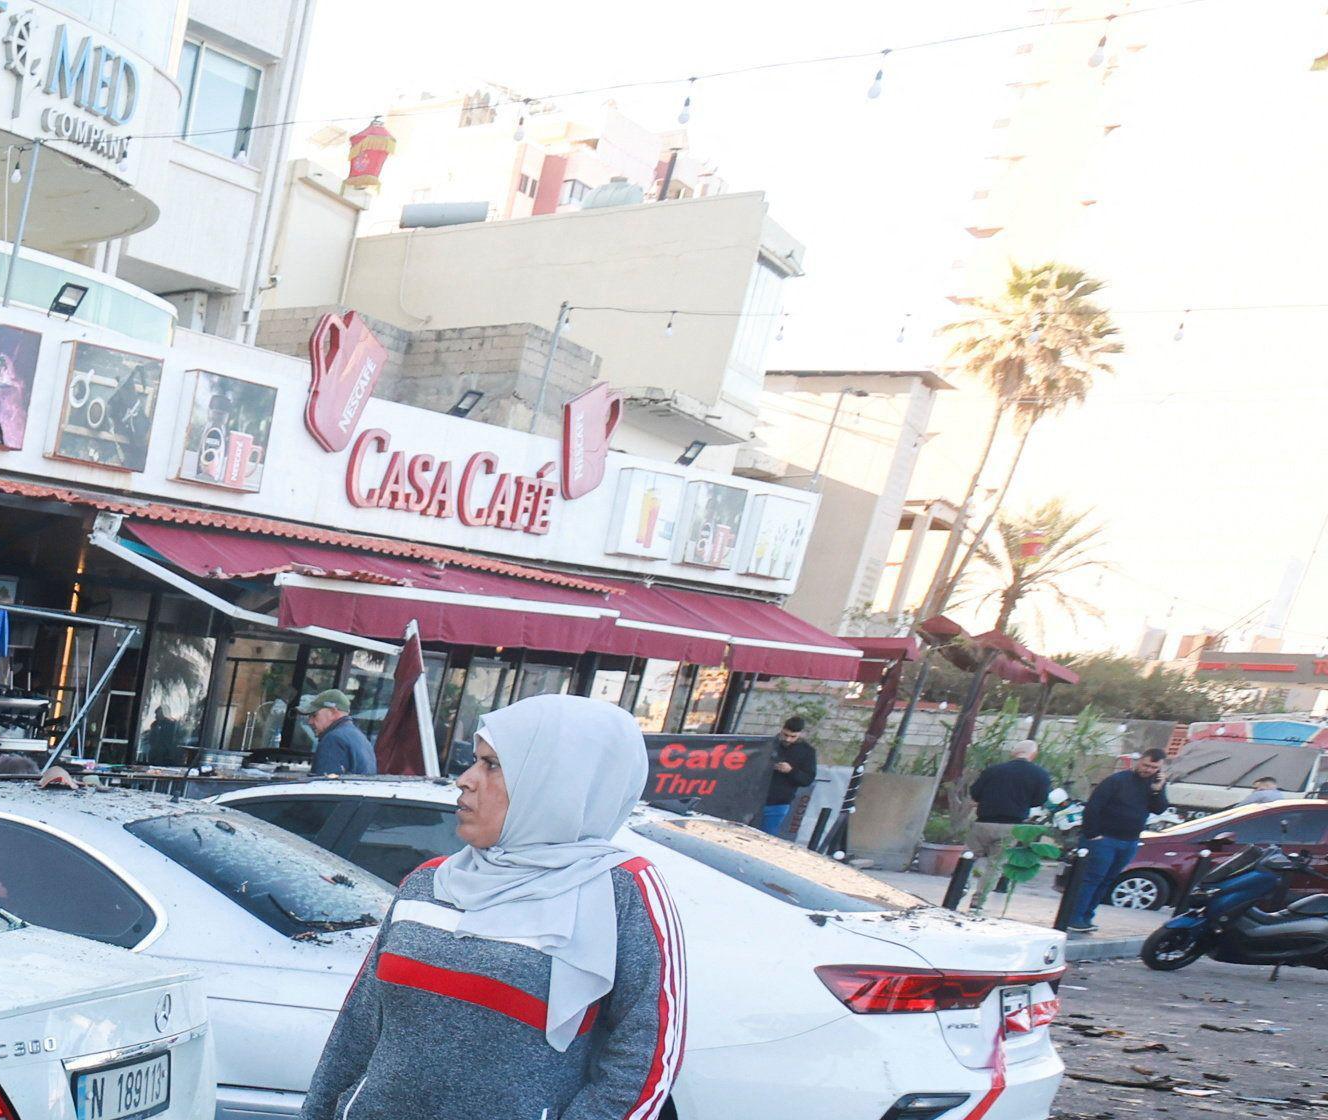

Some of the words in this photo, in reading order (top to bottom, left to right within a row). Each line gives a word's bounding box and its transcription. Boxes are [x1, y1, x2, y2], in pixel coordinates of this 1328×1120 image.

[43, 24, 140, 126] MED
[41, 107, 130, 164] COMPANY
[346, 428, 454, 518] CASA
[457, 451, 557, 535] CAFÉ
[655, 773, 718, 796] Thru
[659, 743, 748, 771] Café
[14, 1037, 57, 1056] 300
[91, 1077, 105, 1119] N
[117, 1063, 163, 1112] 189113
